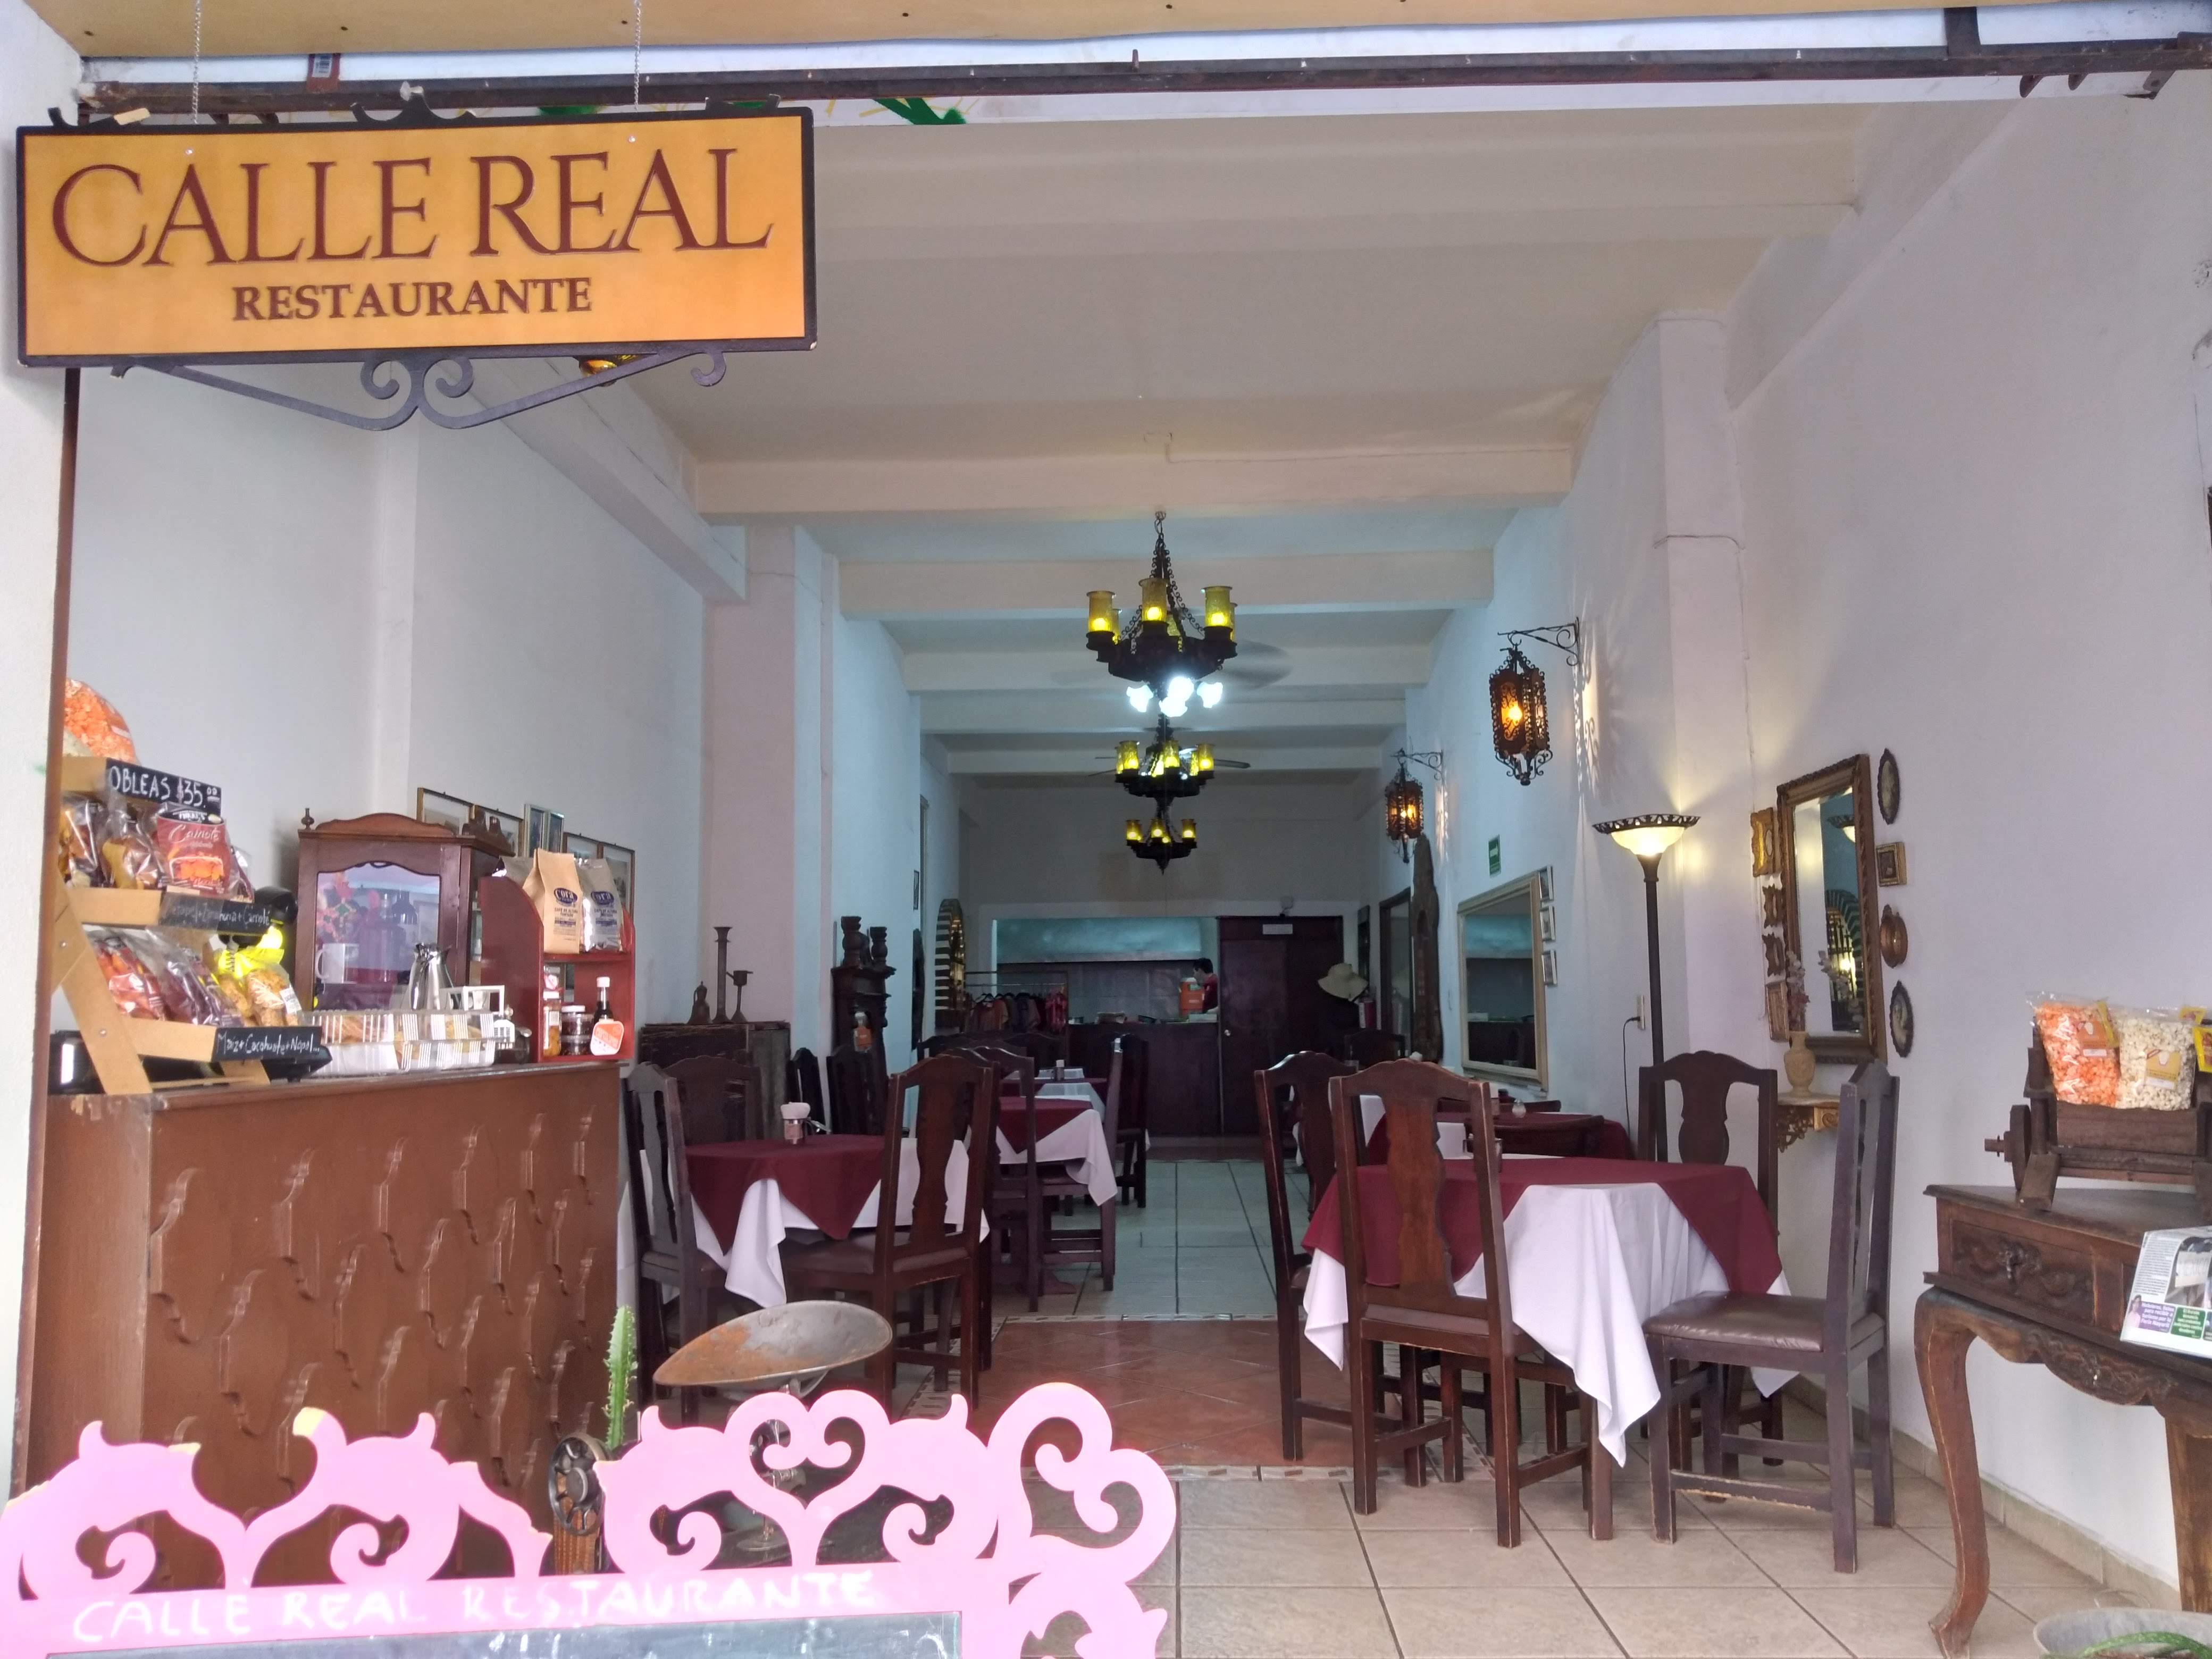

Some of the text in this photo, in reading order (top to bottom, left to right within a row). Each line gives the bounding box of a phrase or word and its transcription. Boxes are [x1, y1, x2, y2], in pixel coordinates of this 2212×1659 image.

[52, 147, 774, 267] CALLE REAL
[232, 277, 592, 321] RESTAURANTE
[108, 765, 171, 801] OBLEAS
[168, 824, 221, 843] Camote
[72, 1569, 877, 1643] CALLE REAL RESTAURANTE
